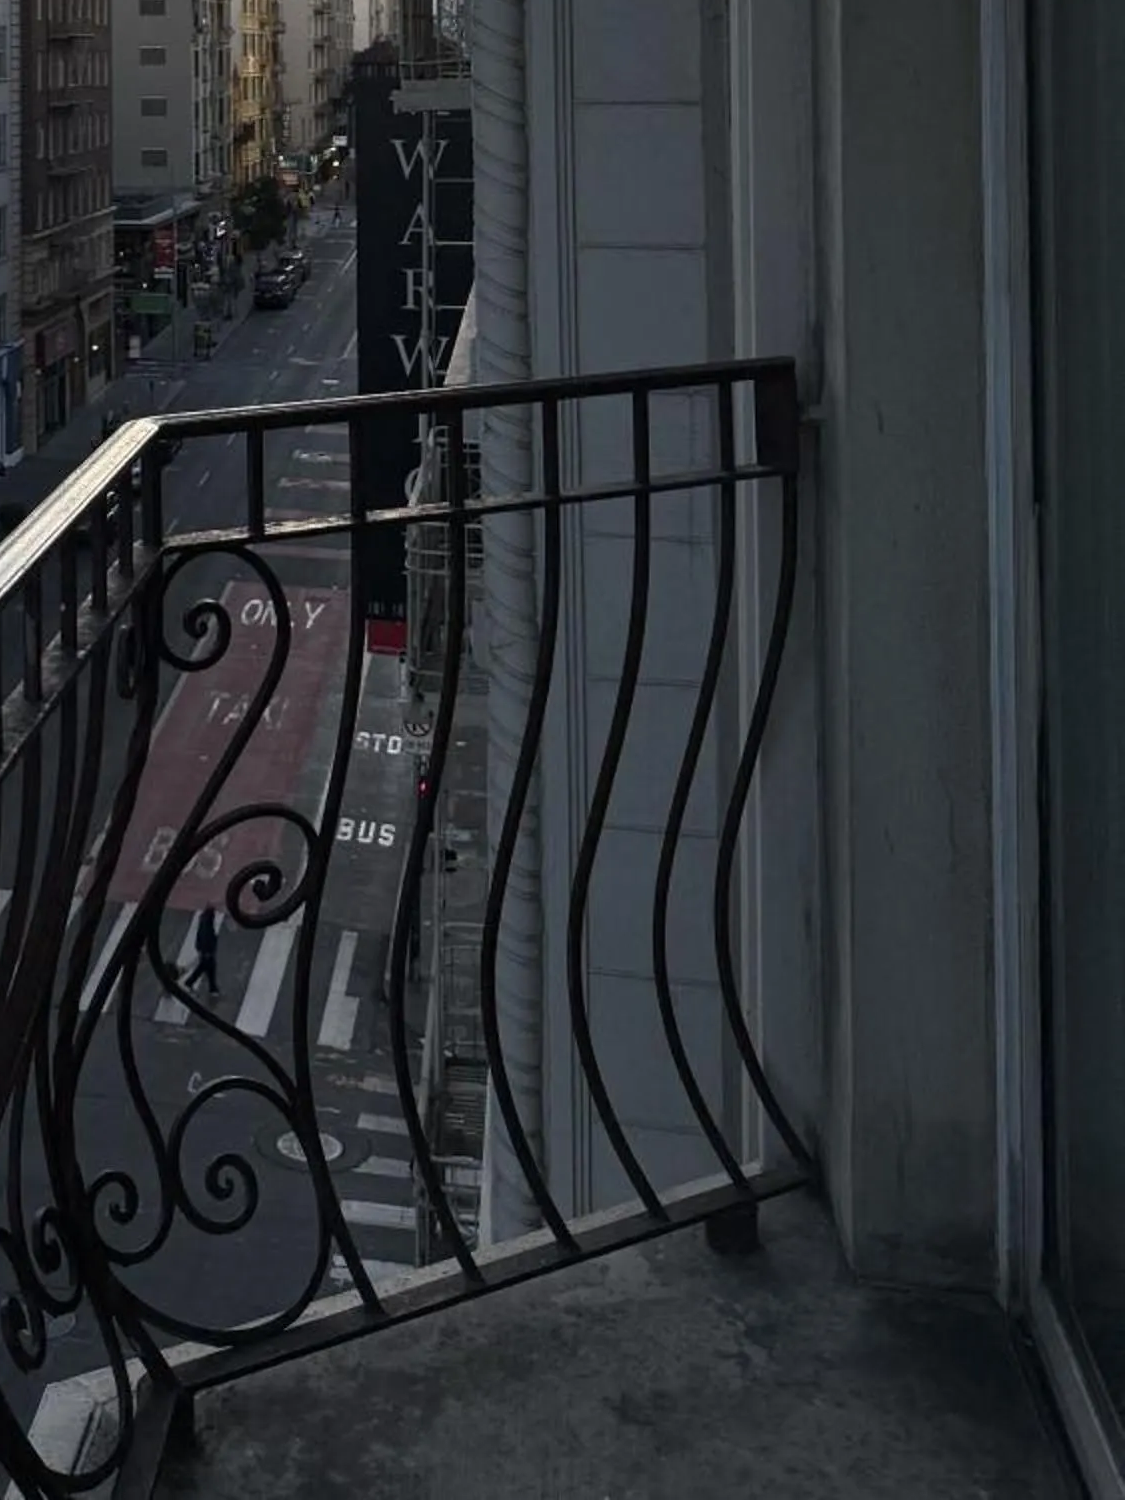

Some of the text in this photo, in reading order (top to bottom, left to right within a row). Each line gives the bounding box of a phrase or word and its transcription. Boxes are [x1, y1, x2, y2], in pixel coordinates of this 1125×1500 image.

[239, 598, 325, 630] ONY
[353, 731, 402, 755] STO
[335, 817, 396, 846] BUS
[141, 825, 229, 880] BS
